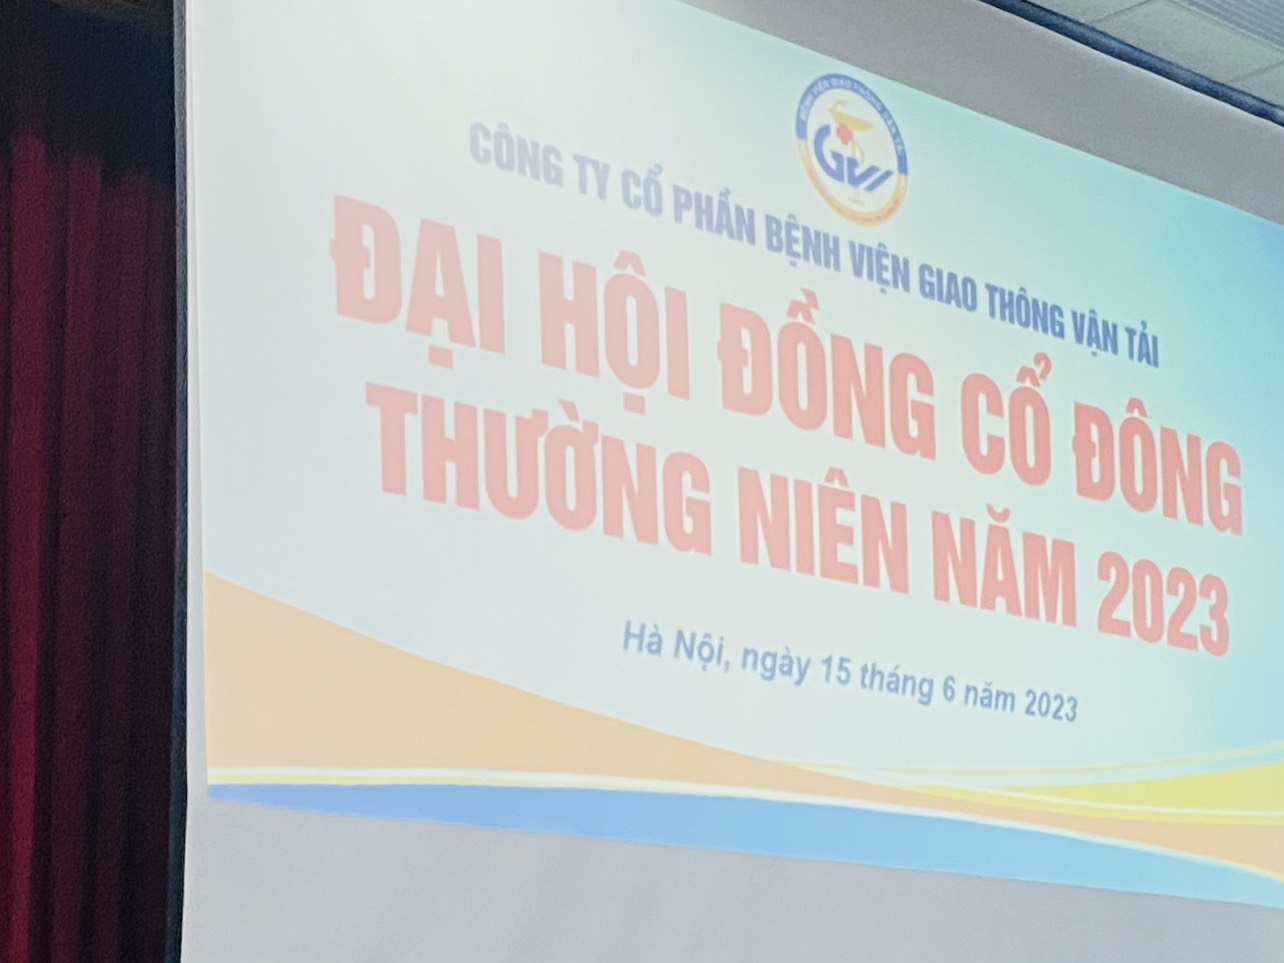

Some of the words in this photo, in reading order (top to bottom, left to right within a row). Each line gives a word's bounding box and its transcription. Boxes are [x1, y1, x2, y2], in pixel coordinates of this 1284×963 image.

[330, 194, 505, 370] ĐẠI
[538, 249, 690, 415] HỘI
[717, 288, 936, 461] ĐỒNG
[960, 352, 1052, 487] CỔ
[1072, 396, 1243, 537] ĐÔNG
[469, 121, 563, 187] CÔNG
[572, 153, 610, 201] TY
[621, 163, 663, 217] CỔ
[672, 187, 756, 246] PHẦN
[765, 213, 841, 272] BỆNH
[848, 240, 911, 295] VIỆN
[919, 263, 978, 313] GIAO
[985, 283, 1065, 339] THÔNG
[1071, 309, 1118, 357] VẬN
[1124, 320, 1159, 368] TẢI
[365, 381, 712, 556] THƯỜNG
[738, 465, 909, 595] NIÊN
[931, 503, 1078, 629] NĂM
[1097, 551, 1229, 657] 2023
[623, 620, 663, 657] Hà
[673, 628, 731, 673] Nội,
[741, 644, 812, 686] ngày
[820, 655, 851, 685] 15
[860, 663, 934, 705] tháng
[943, 675, 956, 703] 6
[964, 681, 1016, 713] năm
[1024, 689, 1079, 723] 2023
